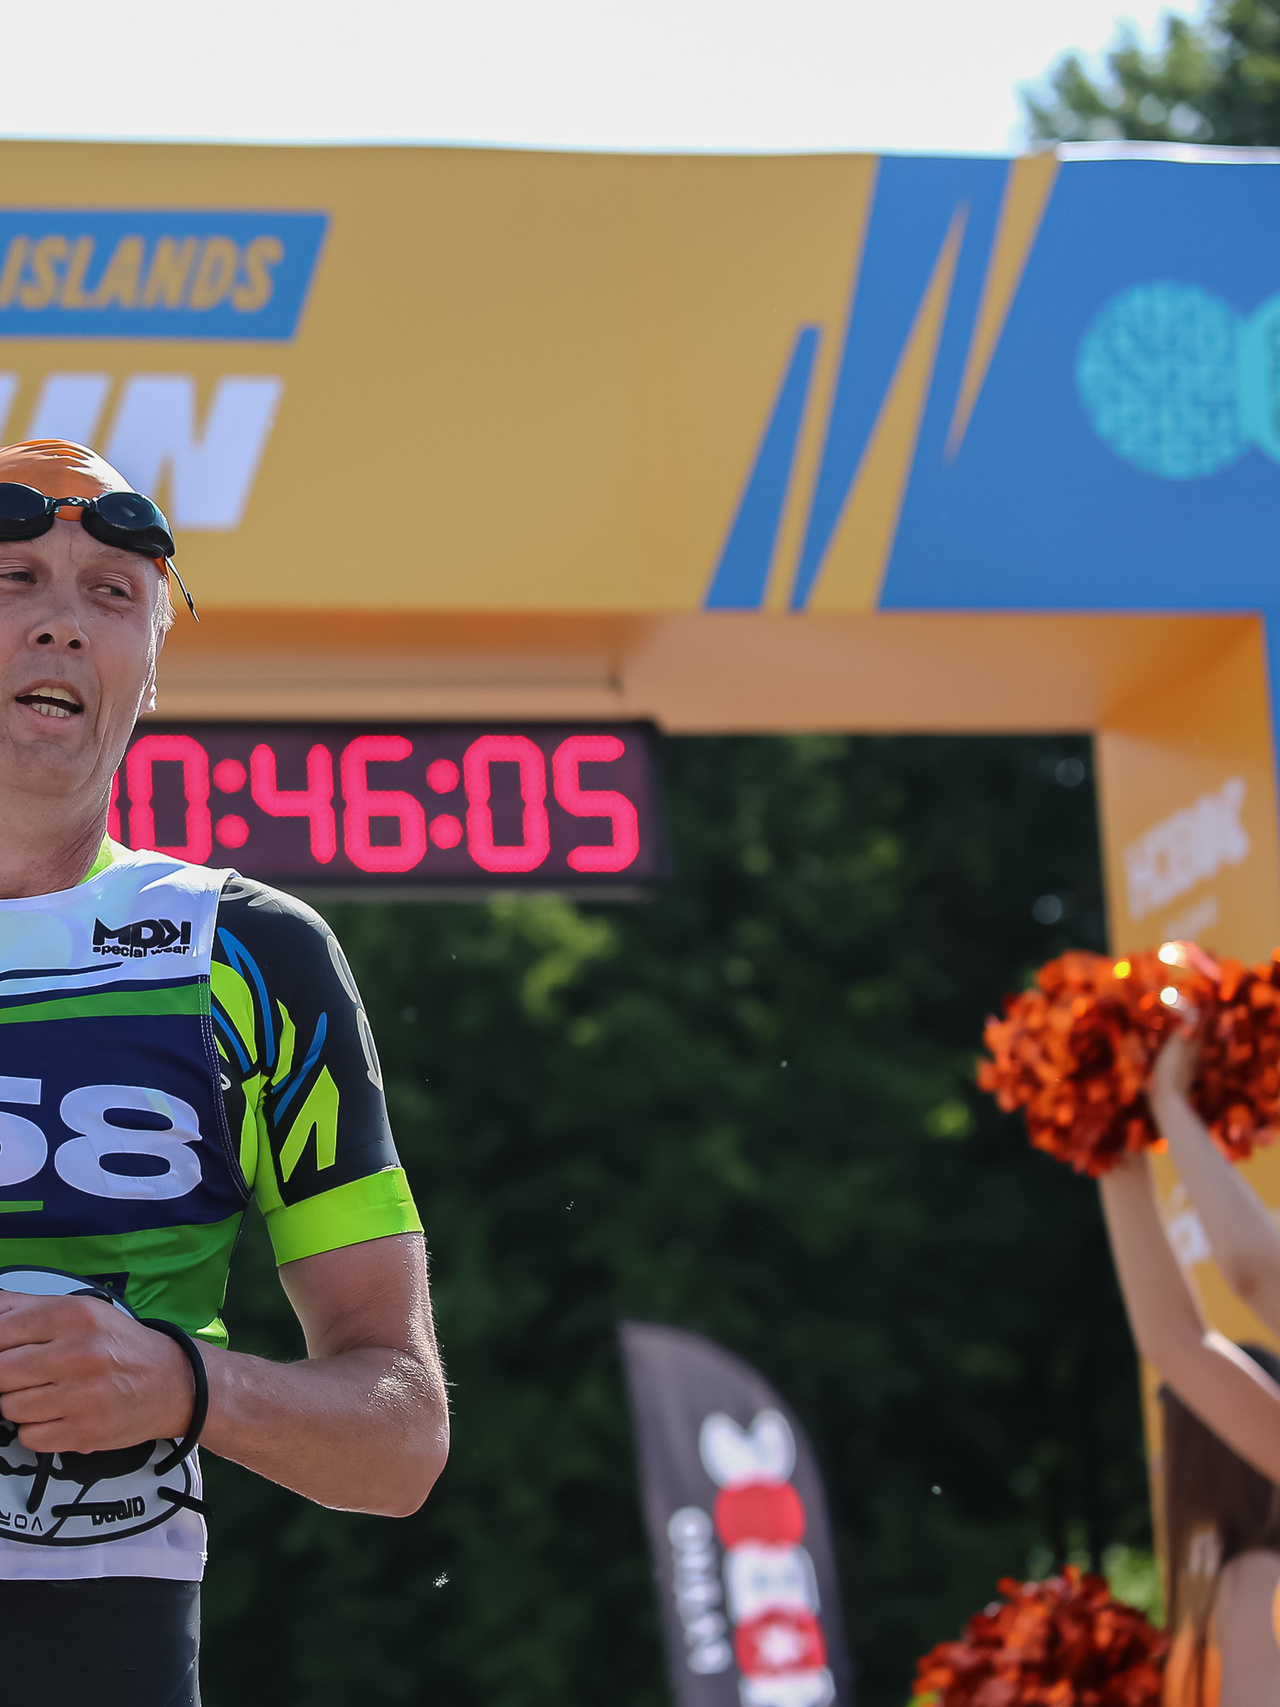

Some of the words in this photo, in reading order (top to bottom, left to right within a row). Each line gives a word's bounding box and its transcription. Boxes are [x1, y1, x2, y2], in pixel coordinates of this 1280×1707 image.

[108, 734, 639, 873] 0:46:05
[92, 945, 148, 958] special
[150, 945, 190, 955] wear
